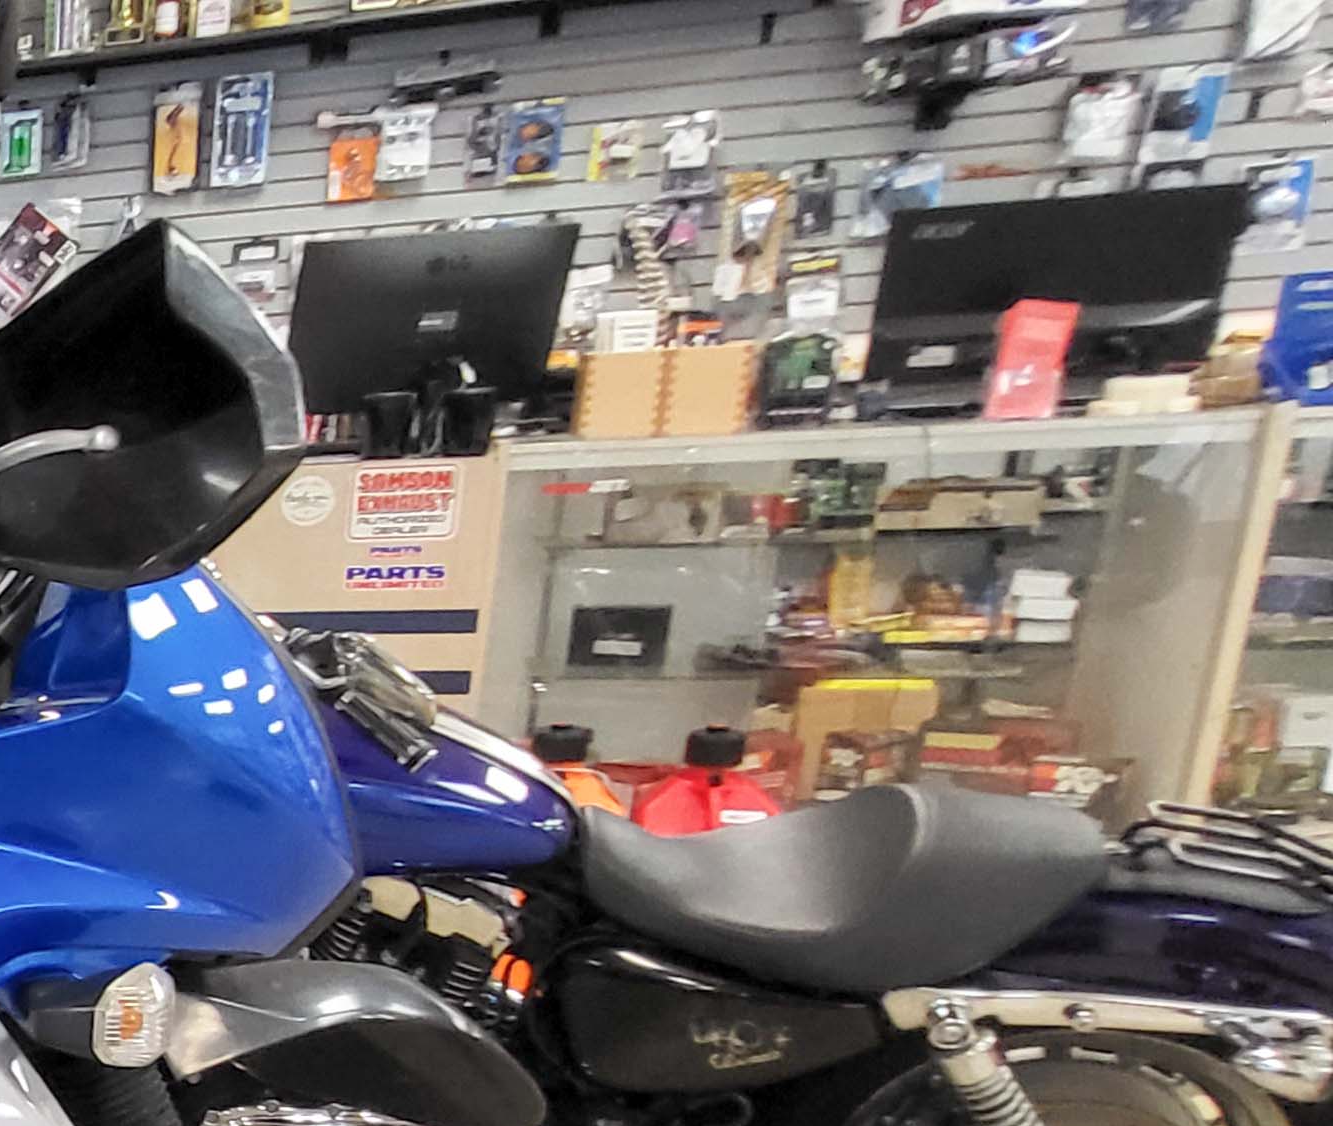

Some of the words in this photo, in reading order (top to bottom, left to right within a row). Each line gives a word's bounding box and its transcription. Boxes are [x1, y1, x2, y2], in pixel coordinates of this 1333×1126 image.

[358, 470, 452, 492] SAMSON
[357, 493, 455, 514] EXHAUST
[346, 565, 446, 580] PARTS
